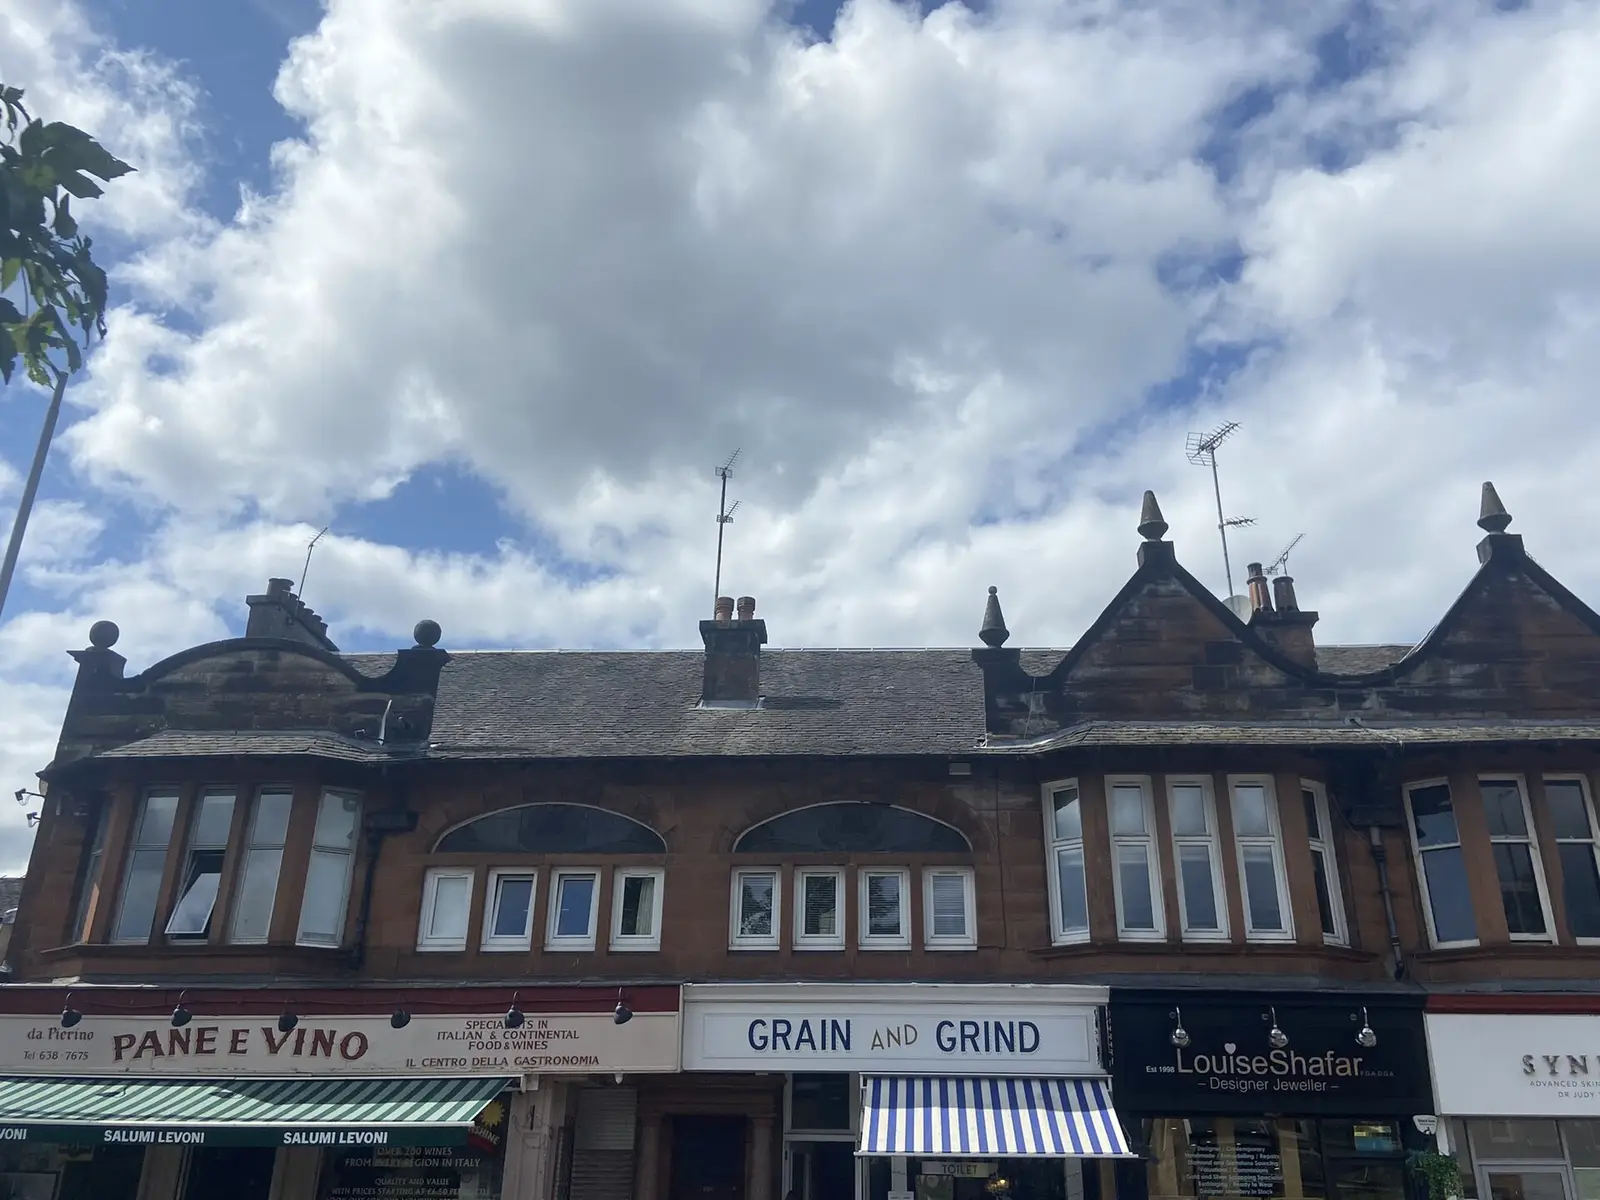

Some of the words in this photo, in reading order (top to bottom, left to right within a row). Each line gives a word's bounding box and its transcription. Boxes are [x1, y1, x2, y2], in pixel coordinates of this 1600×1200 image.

[466, 1020, 534, 1030] SPECIATS
[538, 1020, 548, 1030] IN
[27, 1028, 43, 1040] da
[48, 1027, 94, 1041] Pierino
[437, 1031, 483, 1041] ITALIAN
[489, 1031, 497, 1040] &
[503, 1030, 579, 1040] CONTINENTAL
[748, 1019, 851, 1051] GRAIN
[871, 1024, 918, 1050] AND
[936, 1020, 1040, 1053] GRIND
[113, 1027, 219, 1061] PANE
[229, 1028, 250, 1055] E
[261, 1027, 369, 1060] VINO
[468, 1041, 502, 1050] FOOD
[503, 1042, 510, 1050] &
[511, 1041, 549, 1050] WINES
[406, 1058, 417, 1067] IL
[422, 1058, 467, 1067] CENTRO
[471, 1057, 509, 1067] DELLA
[514, 1056, 600, 1066] GASTRONOMIA
[1146, 1065, 1158, 1073] Est
[1209, 1076, 1269, 1093] Designer
[1273, 1078, 1327, 1092] Jeweller
[1530, 1080, 1578, 1088] ADVANCED
[104, 1130, 155, 1143] SALUMI
[158, 1131, 205, 1144] LEVONI
[283, 1131, 335, 1145] SALUMI
[338, 1131, 388, 1145] LEVONI
[377, 1147, 401, 1156] OVER
[424, 1147, 452, 1156] WINES
[345, 1158, 372, 1167] FROM
[442, 1158, 452, 1167] IN
[455, 1158, 481, 1167] ITALY
[942, 1164, 978, 1175] TOILET
[375, 1178, 407, 1187] QUALITY
[409, 1178, 424, 1186] AND
[426, 1178, 450, 1186] VALUE
[352, 1187, 375, 1195] PRICES
[378, 1187, 413, 1195] STARTING
